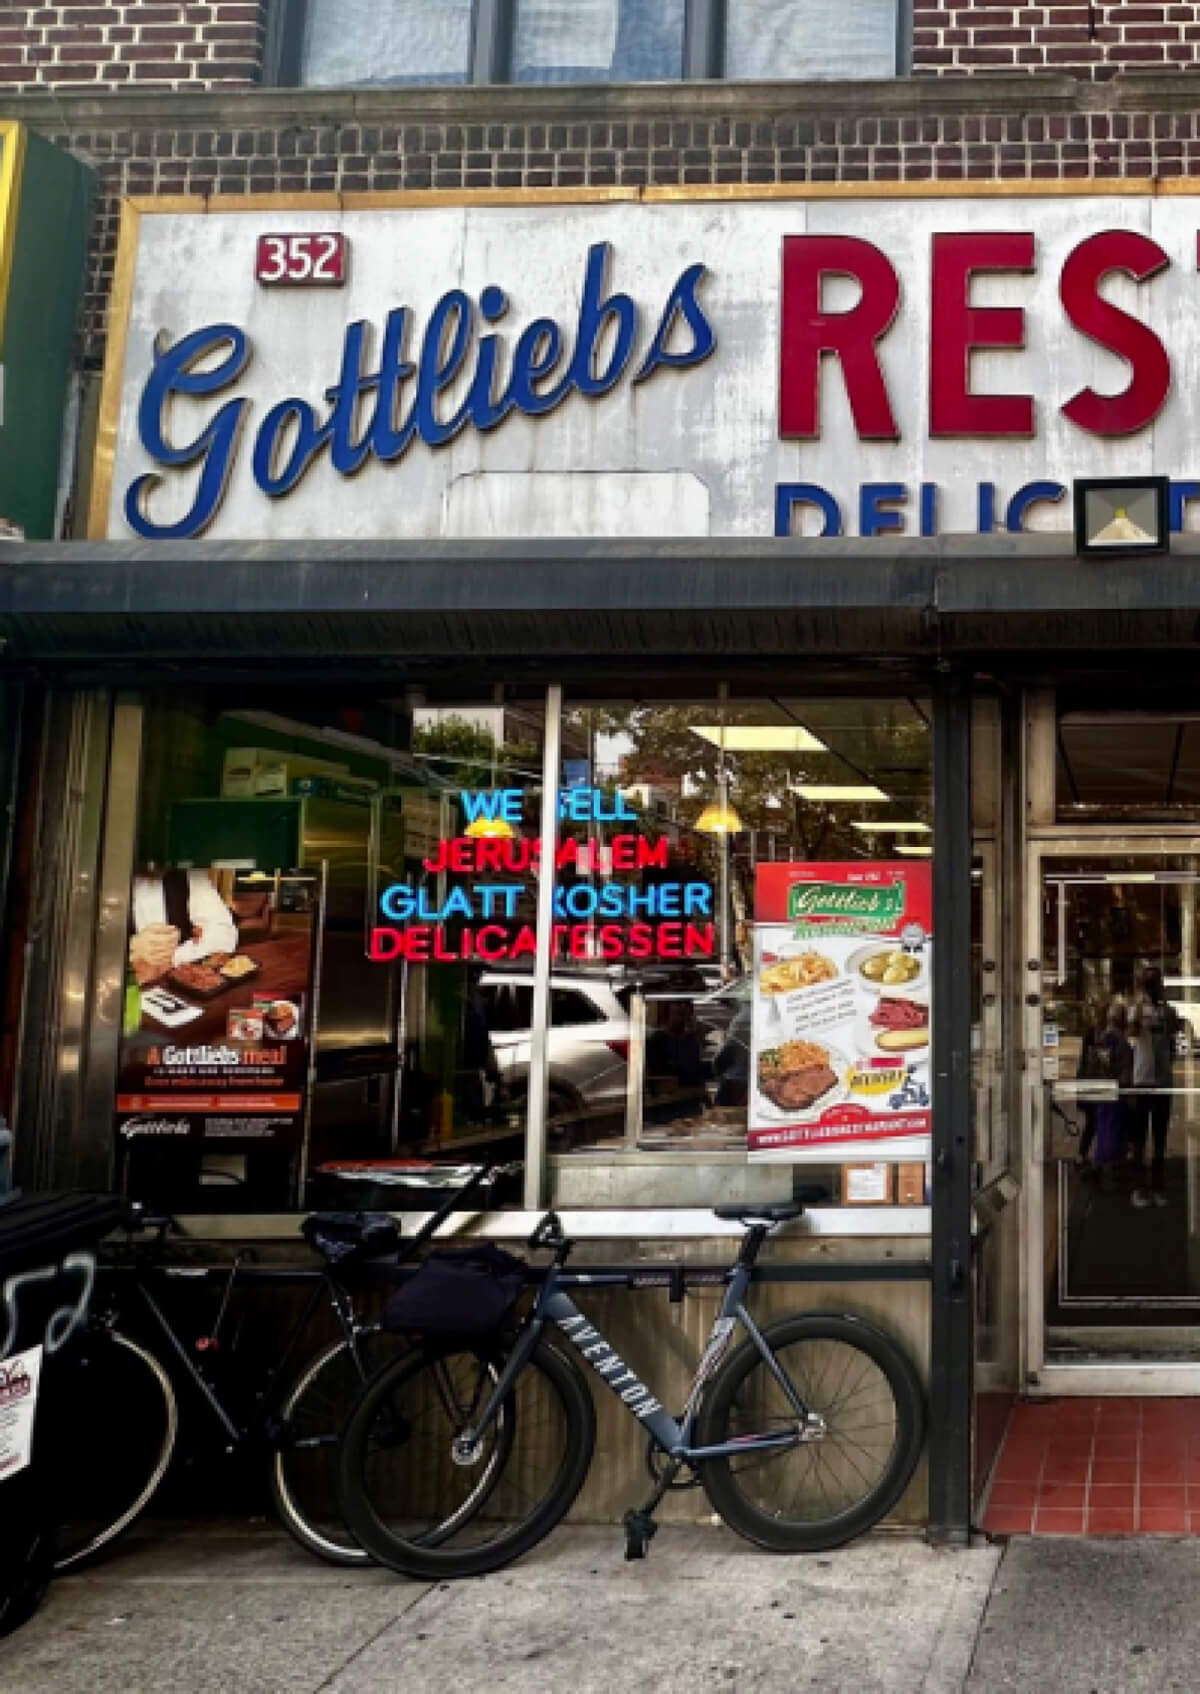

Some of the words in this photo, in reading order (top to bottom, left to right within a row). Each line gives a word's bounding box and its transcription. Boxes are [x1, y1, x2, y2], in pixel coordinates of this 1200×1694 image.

[259, 235, 338, 281] 352
[125, 241, 718, 540] Gottliebs
[461, 788, 524, 822] WE
[380, 884, 526, 920] GLATT
